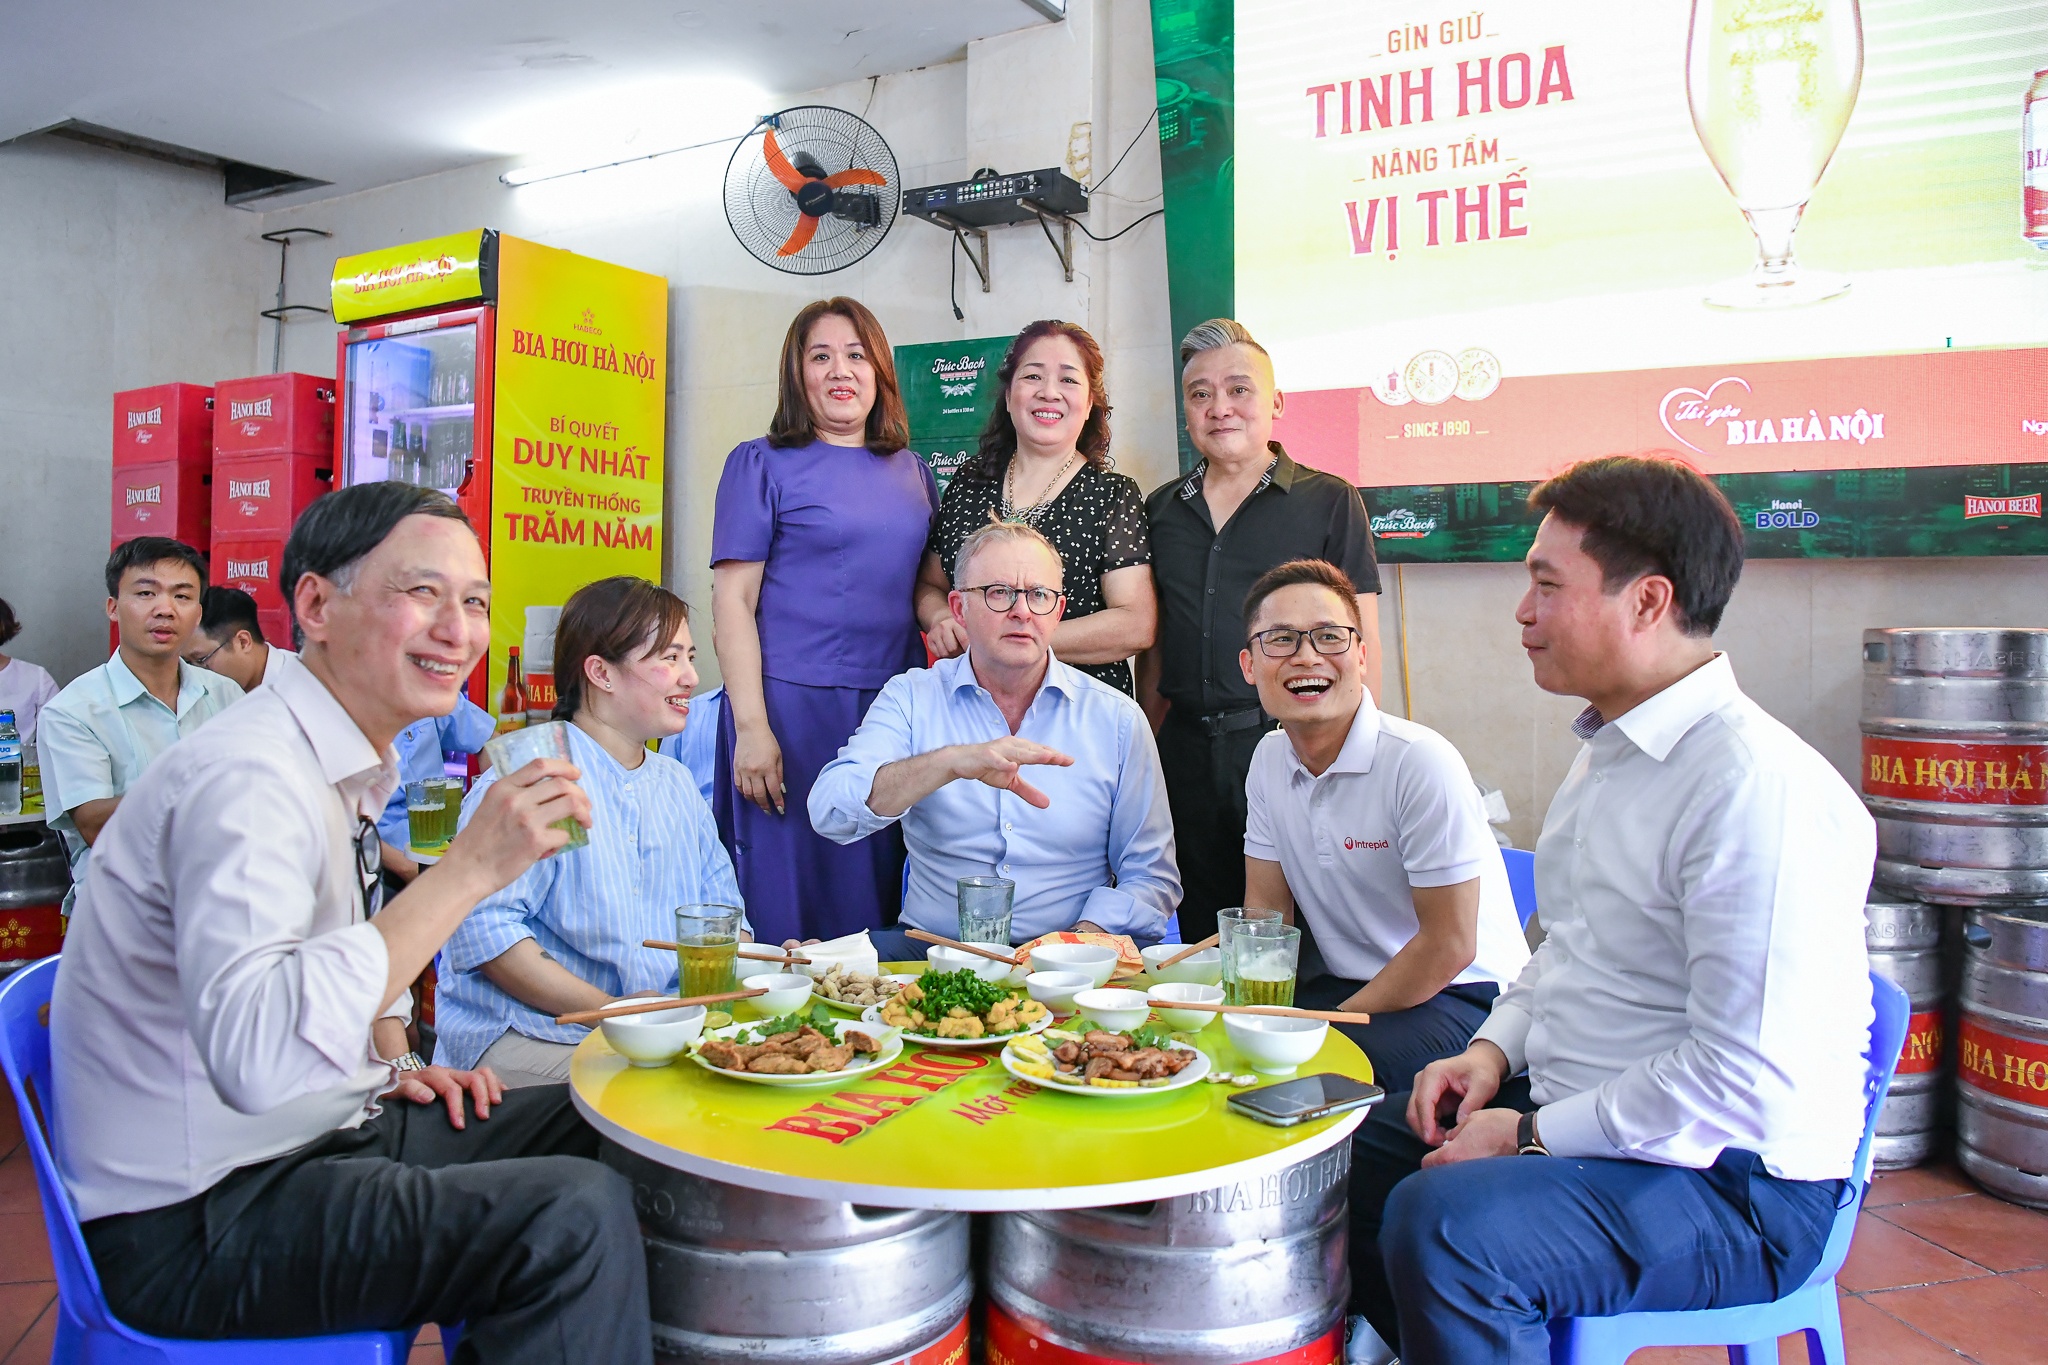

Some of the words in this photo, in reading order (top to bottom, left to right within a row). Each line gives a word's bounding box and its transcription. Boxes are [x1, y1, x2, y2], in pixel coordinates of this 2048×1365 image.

[1387, 23, 1428, 54] GÌN
[1440, 11, 1484, 45] GIỮ
[1306, 66, 1434, 138] TINH
[1456, 45, 1575, 117] HOA
[1371, 147, 1438, 180] NÂNG
[1447, 134, 1499, 169] TẦM
[1344, 195, 1399, 261] VỊ
[1416, 167, 1528, 246] THẾ
[573, 323, 602, 336] HABECO
[512, 329, 547, 359] BIA
[551, 337, 588, 367] HƠI
[592, 343, 619, 373] HÀ
[623, 351, 655, 384] NỘI
[932, 358, 956, 374] Trúc
[957, 355, 985, 371] Bạch
[127, 409, 146, 430] HANOI
[147, 406, 162, 425] BEER
[231, 400, 254, 421] HANOI
[254, 397, 273, 417] BEER
[550, 415, 566, 433] BÍ
[569, 420, 619, 441] QUYẾT
[1403, 421, 1439, 438] SINCE
[1442, 420, 1471, 436] 1890
[1727, 419, 1778, 445] BIA
[1781, 409, 1826, 442] HÀ
[1829, 408, 1884, 445] NỘI
[514, 437, 573, 470] DUY
[580, 446, 650, 480] NHẤT
[929, 452, 953, 468] Trúc
[126, 487, 145, 506] HANOI
[146, 485, 161, 503] BEER
[229, 480, 252, 499] HANOI
[252, 478, 271, 498] BEER
[521, 486, 584, 508] TRUYỀN
[588, 492, 641, 513] THỐNG
[1771, 499, 1803, 510] Hanoi
[1967, 498, 2007, 515] HANOI
[2008, 497, 2038, 514] BEER
[504, 510, 585, 546] TRĂM
[593, 516, 653, 551] NĂM
[1370, 516, 1399, 531] Trúc
[1399, 516, 1435, 532] Bạch
[1756, 511, 1819, 529] BOLD
[227, 561, 250, 579] HANOI
[250, 559, 269, 579] BEER
[1870, 754, 1909, 786] BIA
[1914, 757, 1978, 789] HƠI
[1984, 754, 2034, 791] HÀ
[1354, 839, 1389, 851] Intrepid
[1866, 922, 1931, 939] ABECO
[1963, 1037, 1998, 1081] BIA
[762, 1091, 924, 1145] BIA
[950, 1093, 1018, 1126] Một
[1187, 1182, 1254, 1214] BIA
